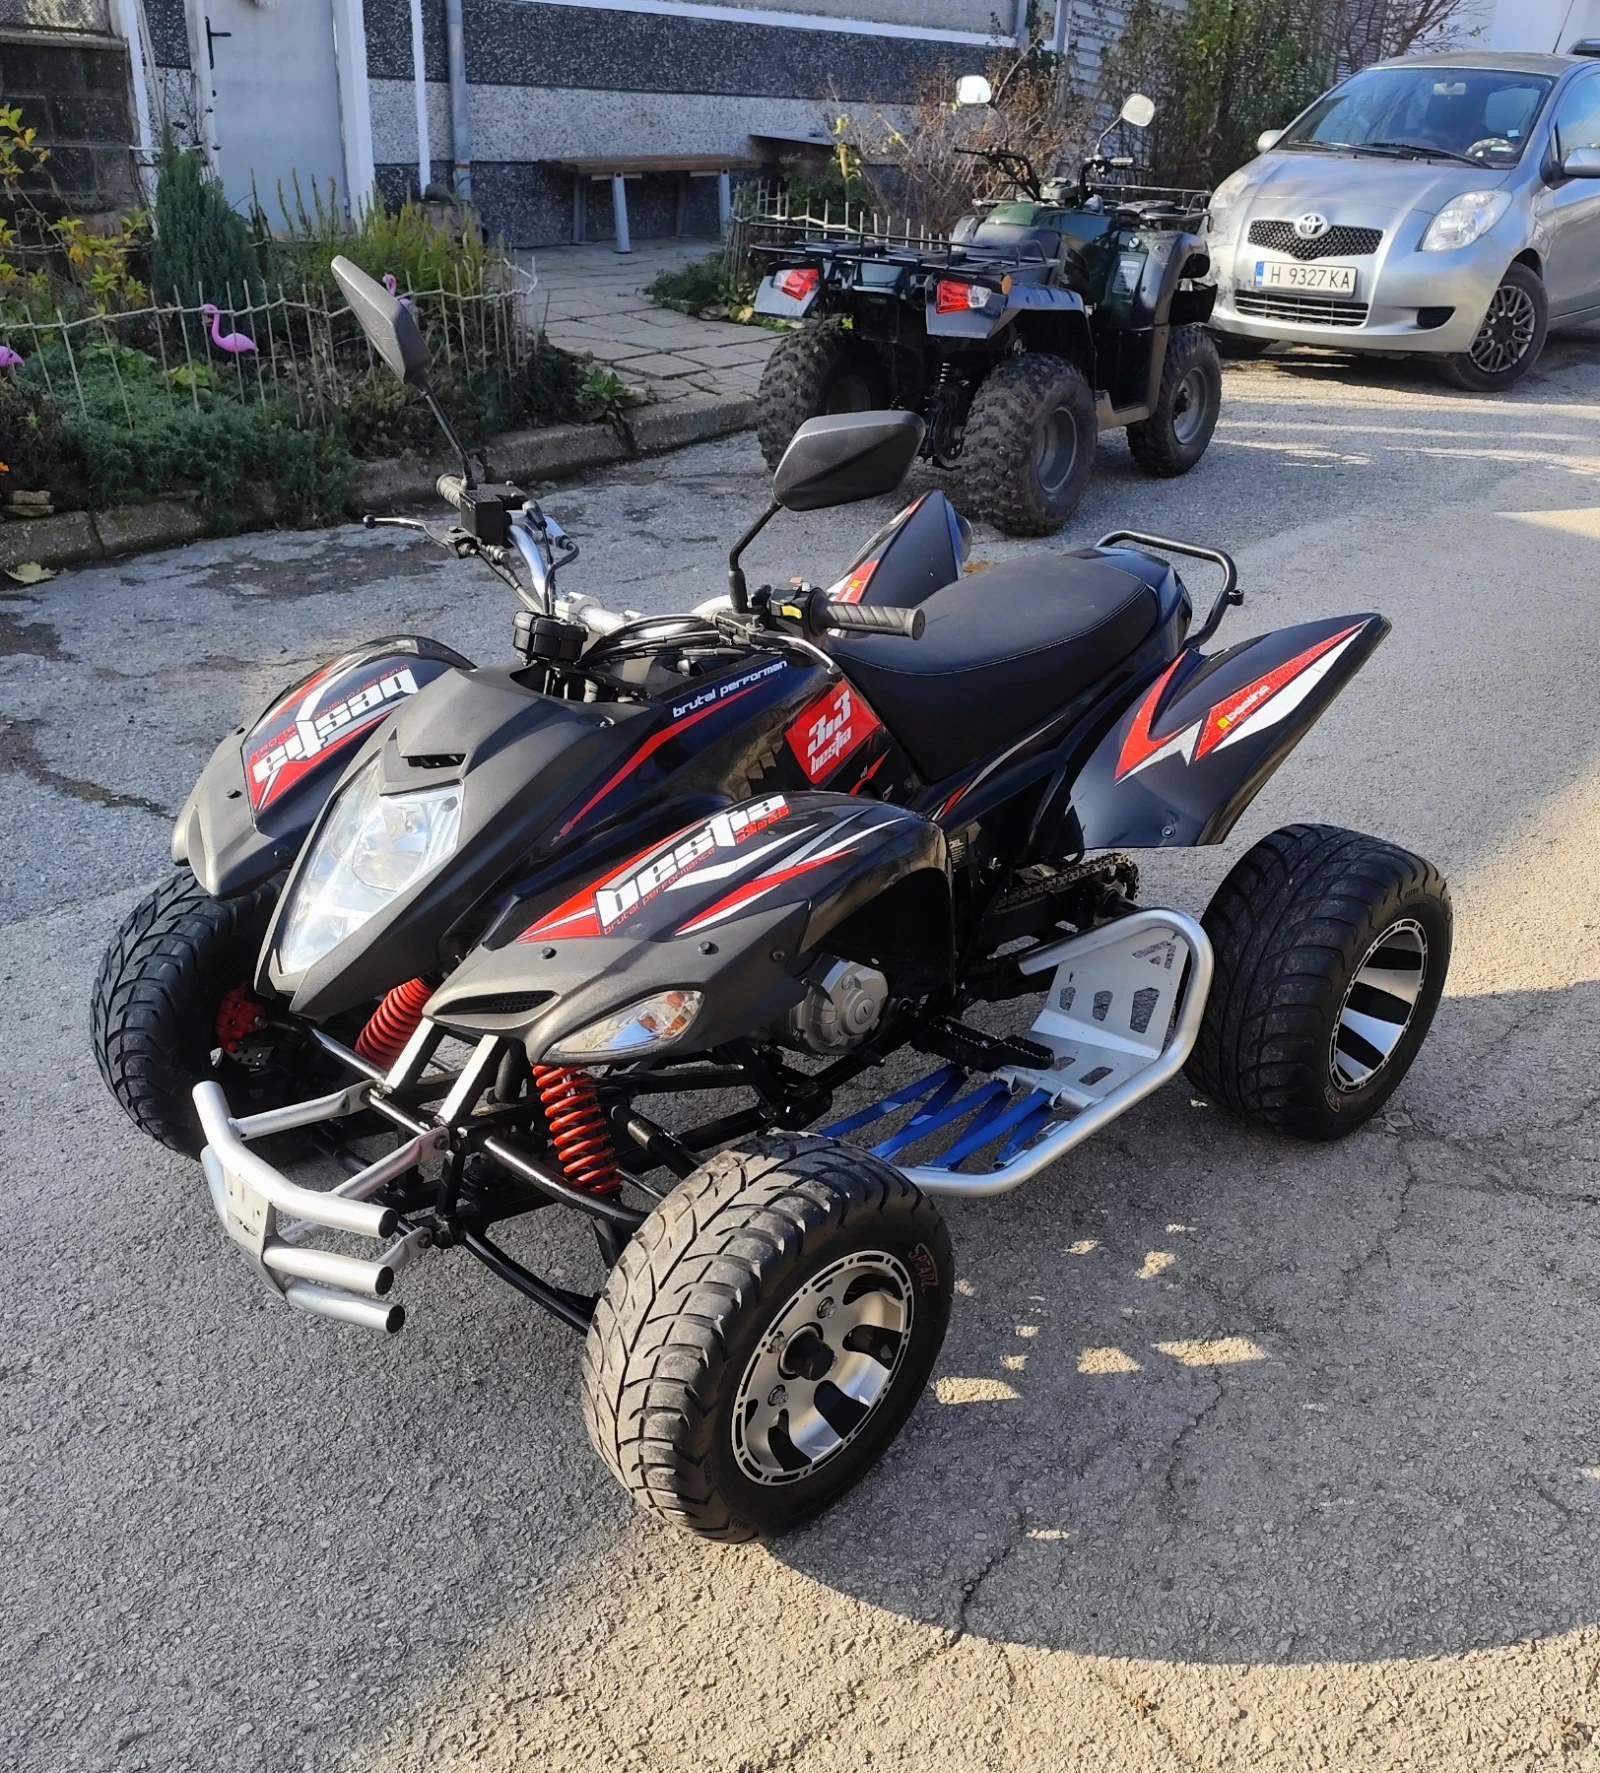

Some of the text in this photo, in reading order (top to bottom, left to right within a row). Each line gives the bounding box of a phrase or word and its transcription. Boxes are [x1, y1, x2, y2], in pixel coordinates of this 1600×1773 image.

[672, 688, 716, 718] brutal
[810, 725, 852, 776] bestia
[595, 794, 787, 928] bestia
[603, 846, 716, 936] brutal performance
